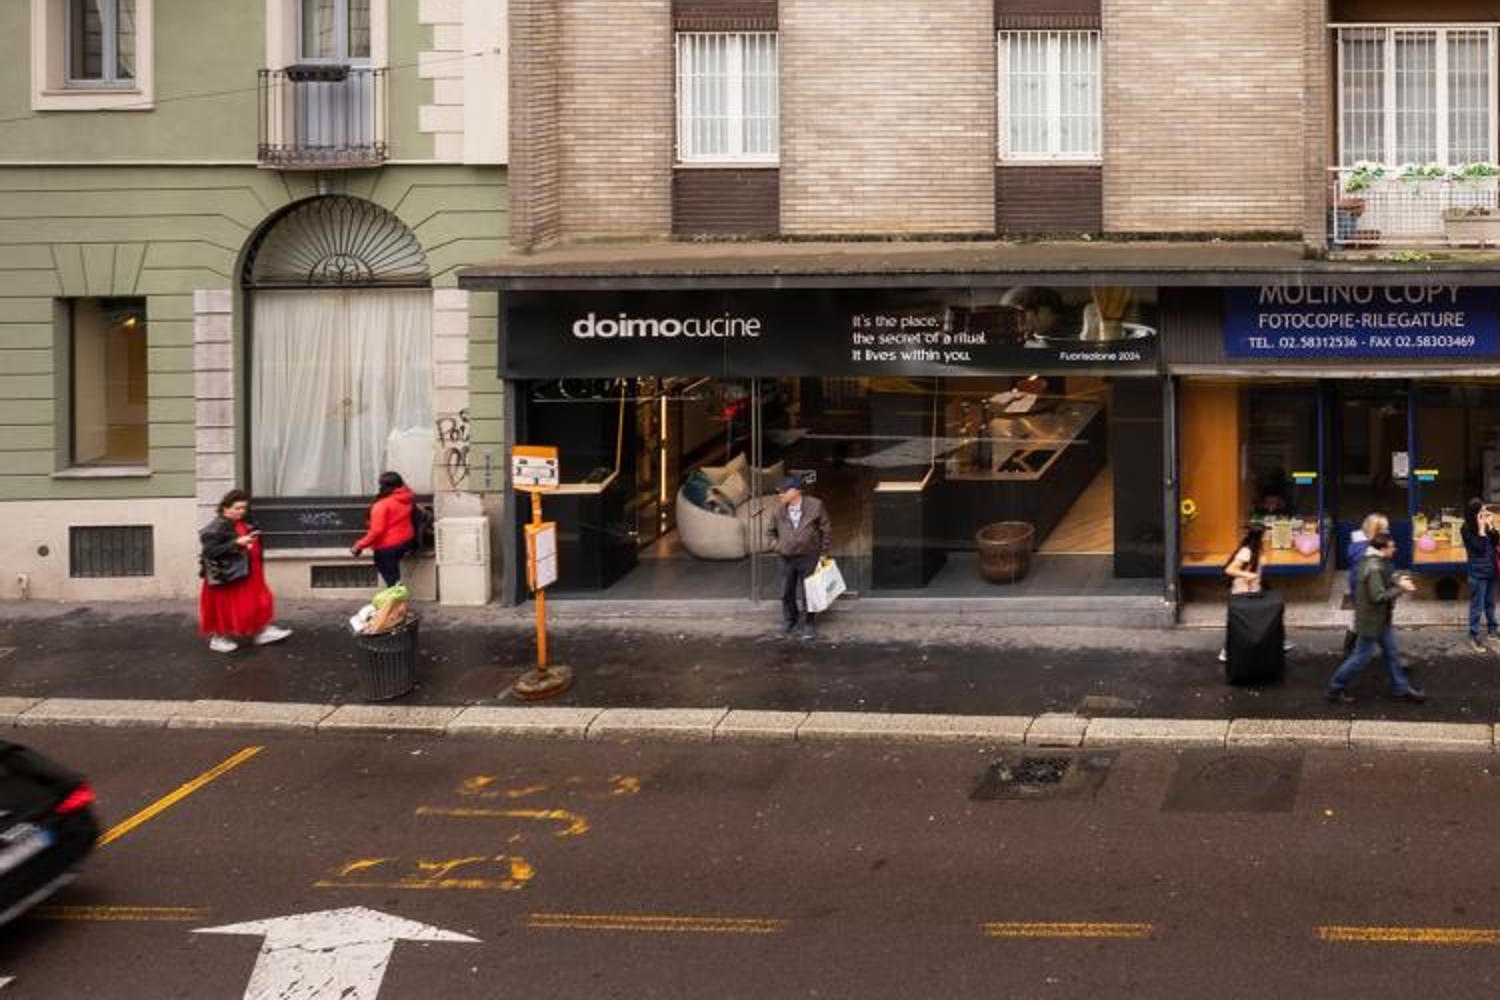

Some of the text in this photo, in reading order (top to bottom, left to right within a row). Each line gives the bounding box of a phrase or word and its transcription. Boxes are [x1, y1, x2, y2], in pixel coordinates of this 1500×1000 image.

[572, 312, 762, 338] doimocucine
[875, 315, 897, 328] the
[900, 315, 940, 330] place.
[1259, 312, 1465, 329] FOTOCOPIE-RILEGATURE
[852, 331, 875, 345] the
[878, 332, 920, 345] secret
[924, 331, 940, 344] of
[943, 333, 952, 345] a
[1248, 336, 1275, 349] TEL.
[1369, 335, 1392, 348] FAX
[865, 348, 897, 361] lives
[900, 348, 940, 361] within
